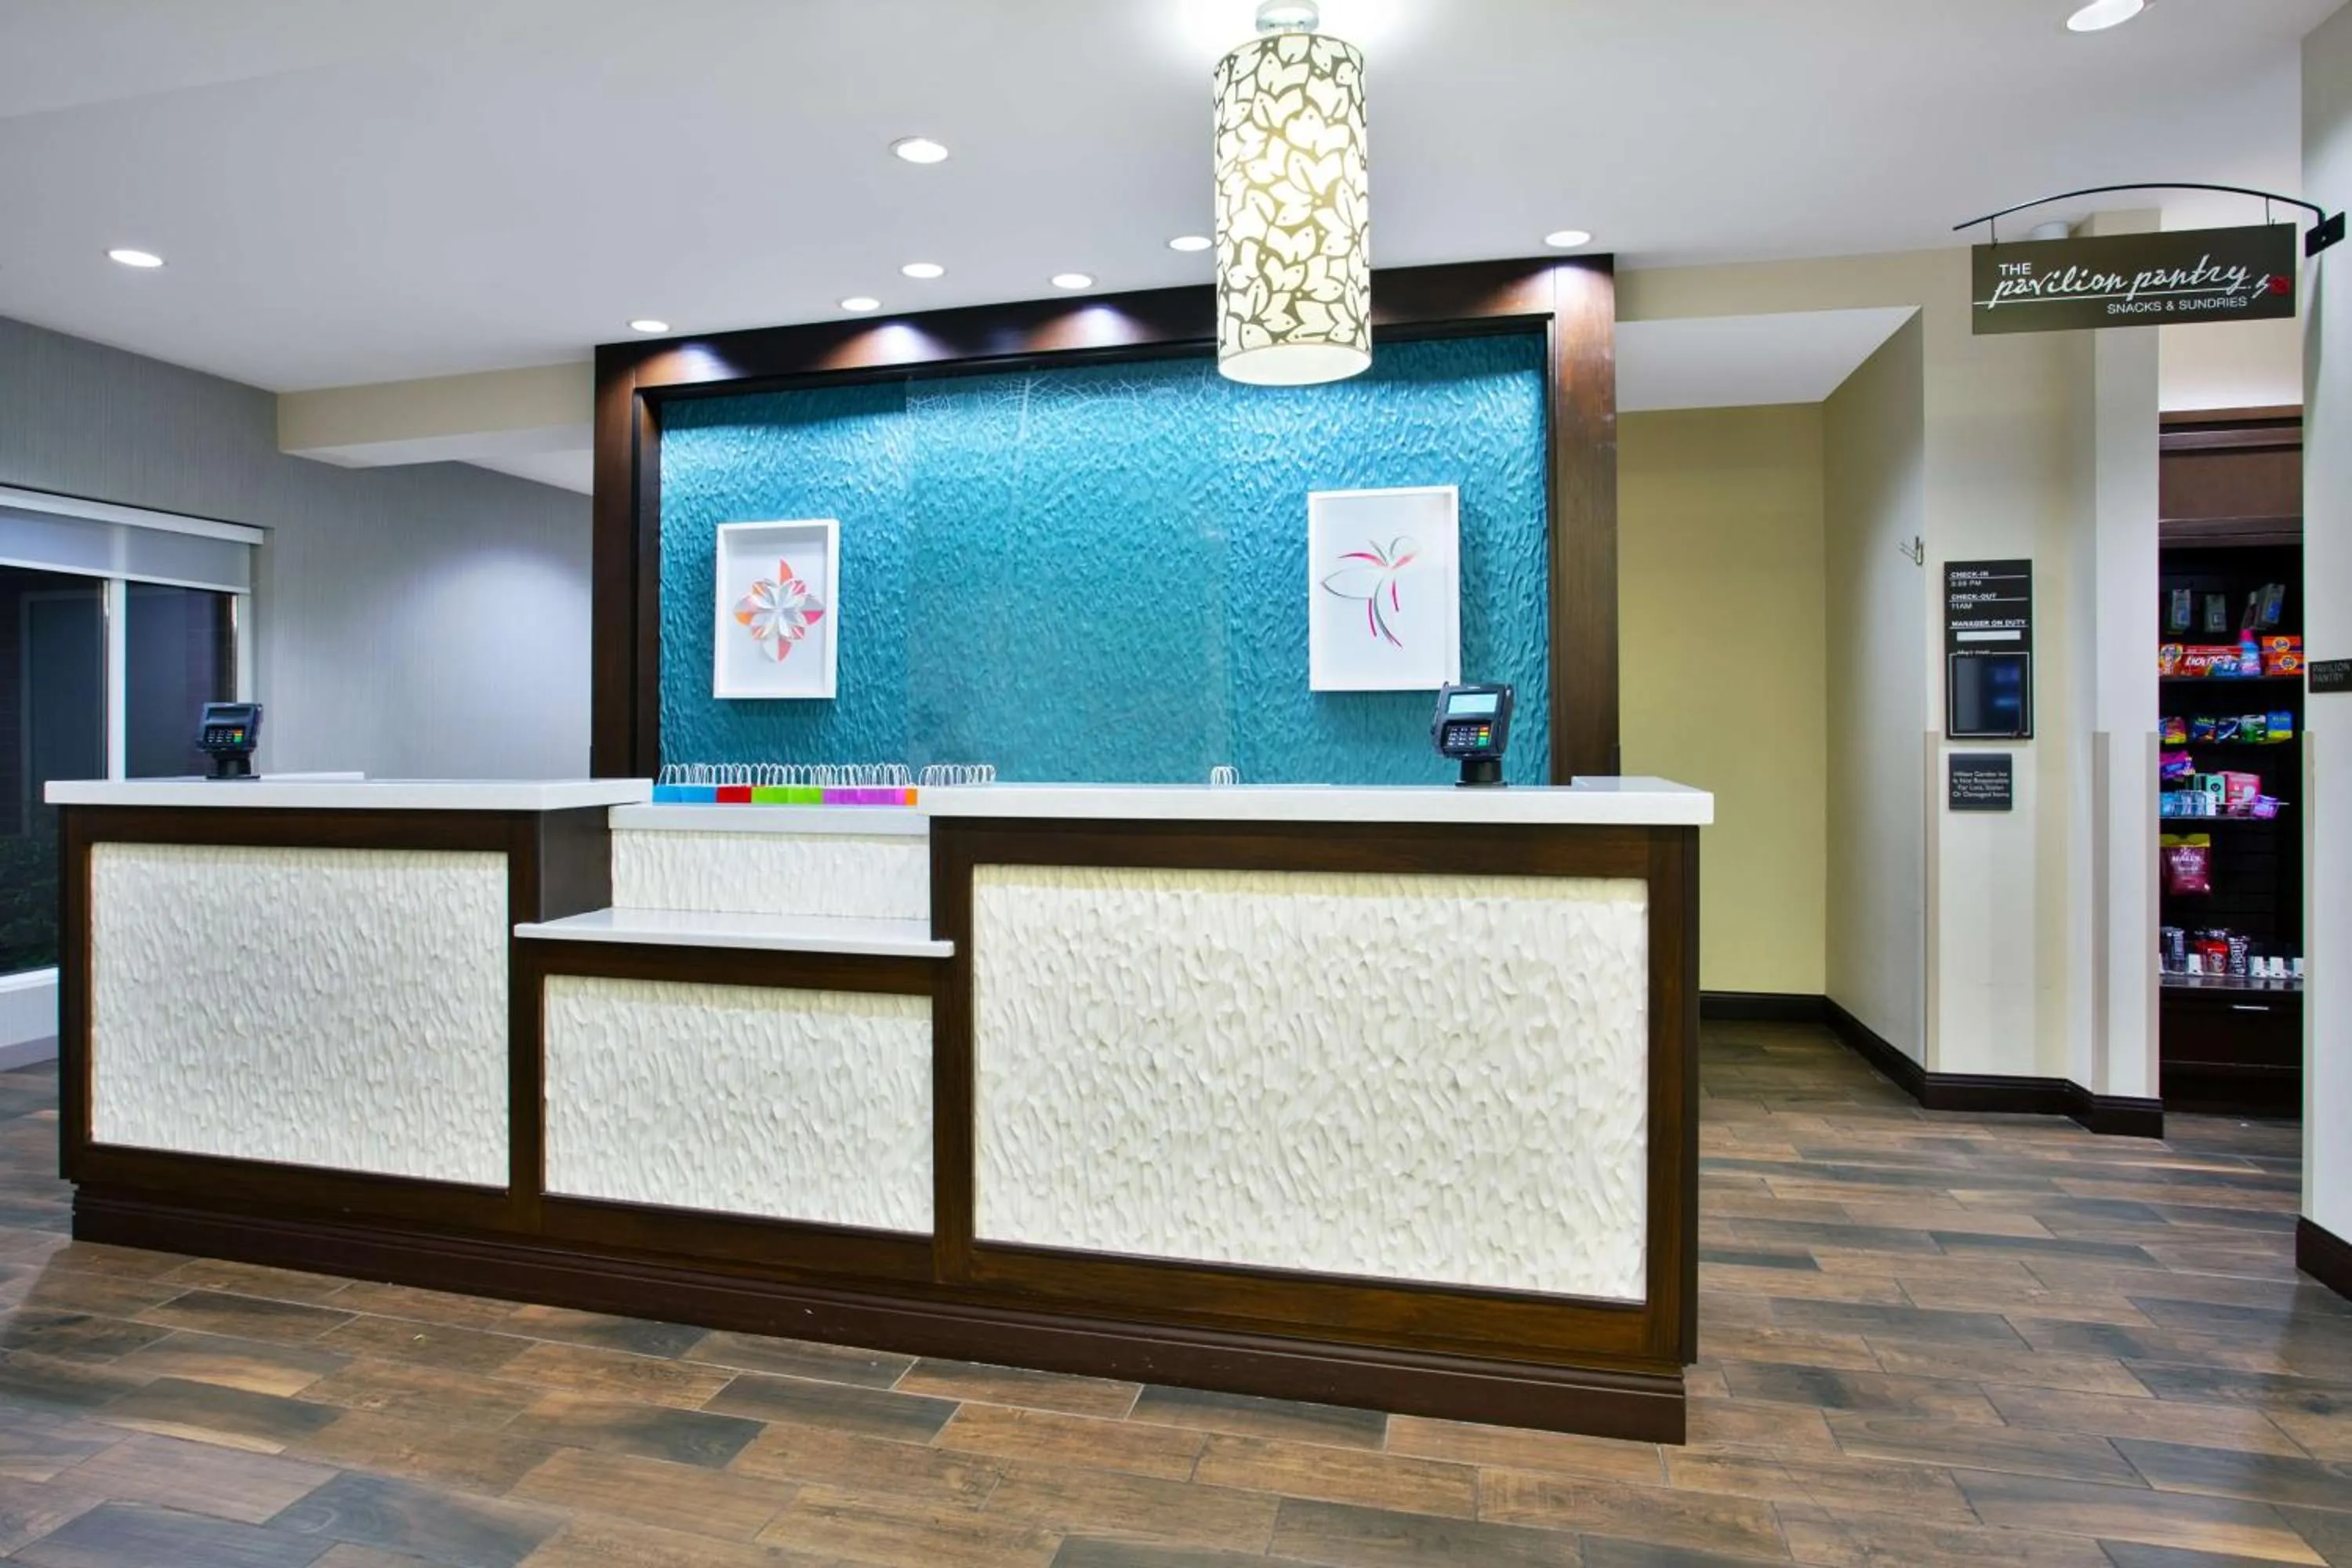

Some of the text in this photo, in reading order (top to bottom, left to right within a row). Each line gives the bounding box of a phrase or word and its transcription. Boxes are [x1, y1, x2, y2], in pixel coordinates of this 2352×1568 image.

[1998, 262, 2032, 276] THE
[1987, 253, 2251, 310] pavilion pantry
[2107, 296, 2249, 314] SNACKS & SUNDRIES
